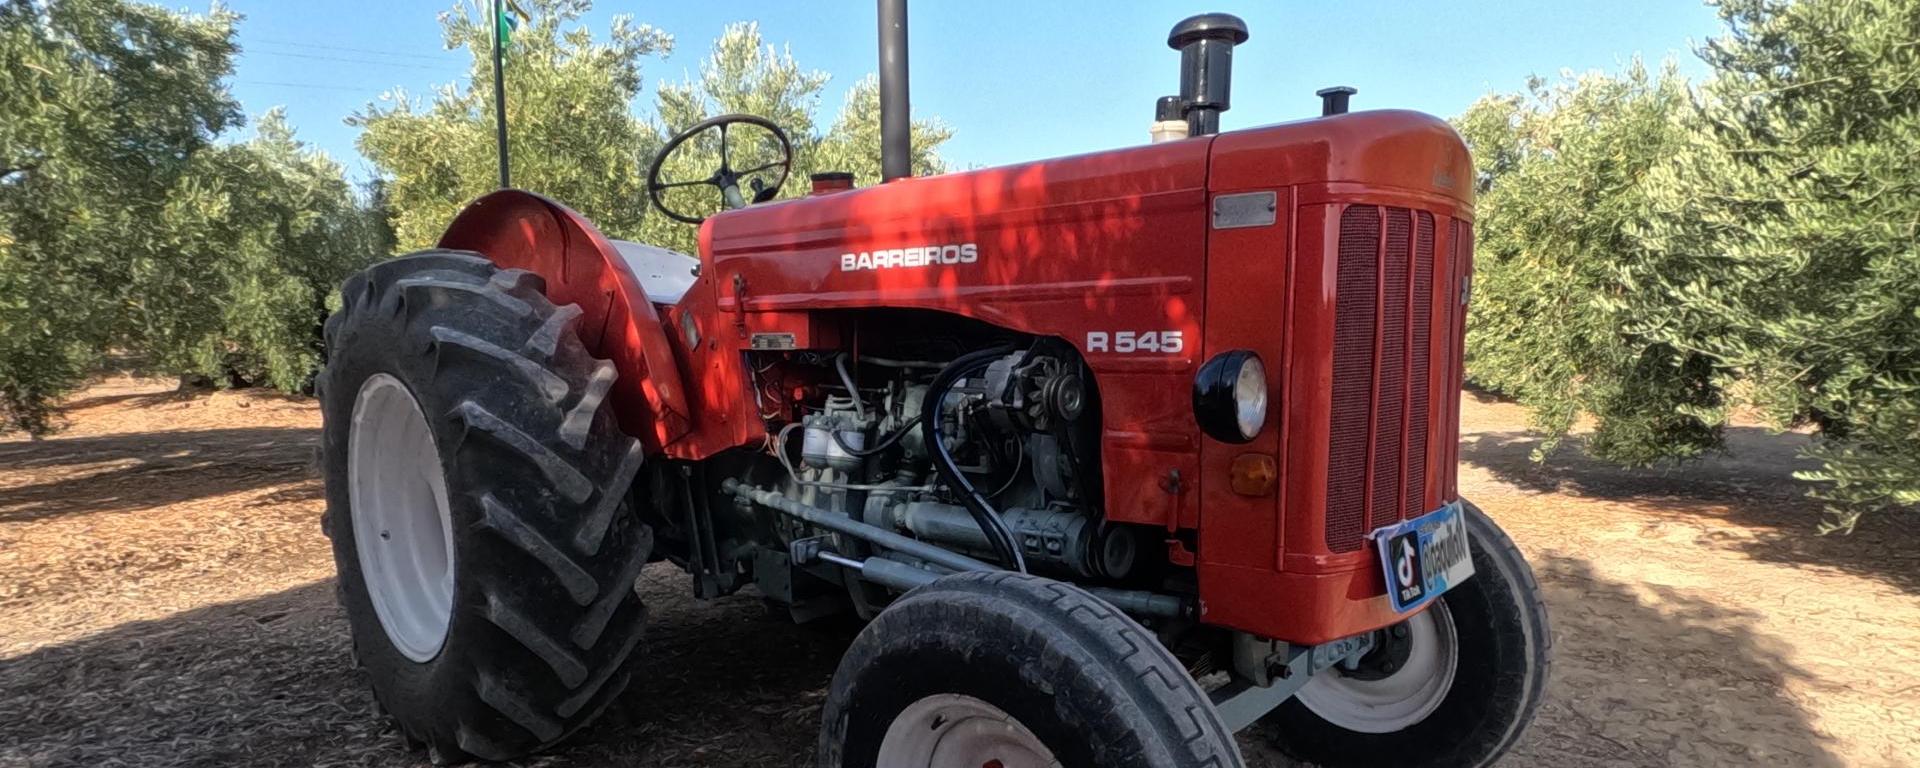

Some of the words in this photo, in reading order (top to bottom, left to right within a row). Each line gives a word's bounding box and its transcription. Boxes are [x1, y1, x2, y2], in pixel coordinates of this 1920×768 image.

[841, 243, 978, 272] BARREIROS
[1086, 331, 1109, 352] R
[1115, 331, 1183, 353] 545
